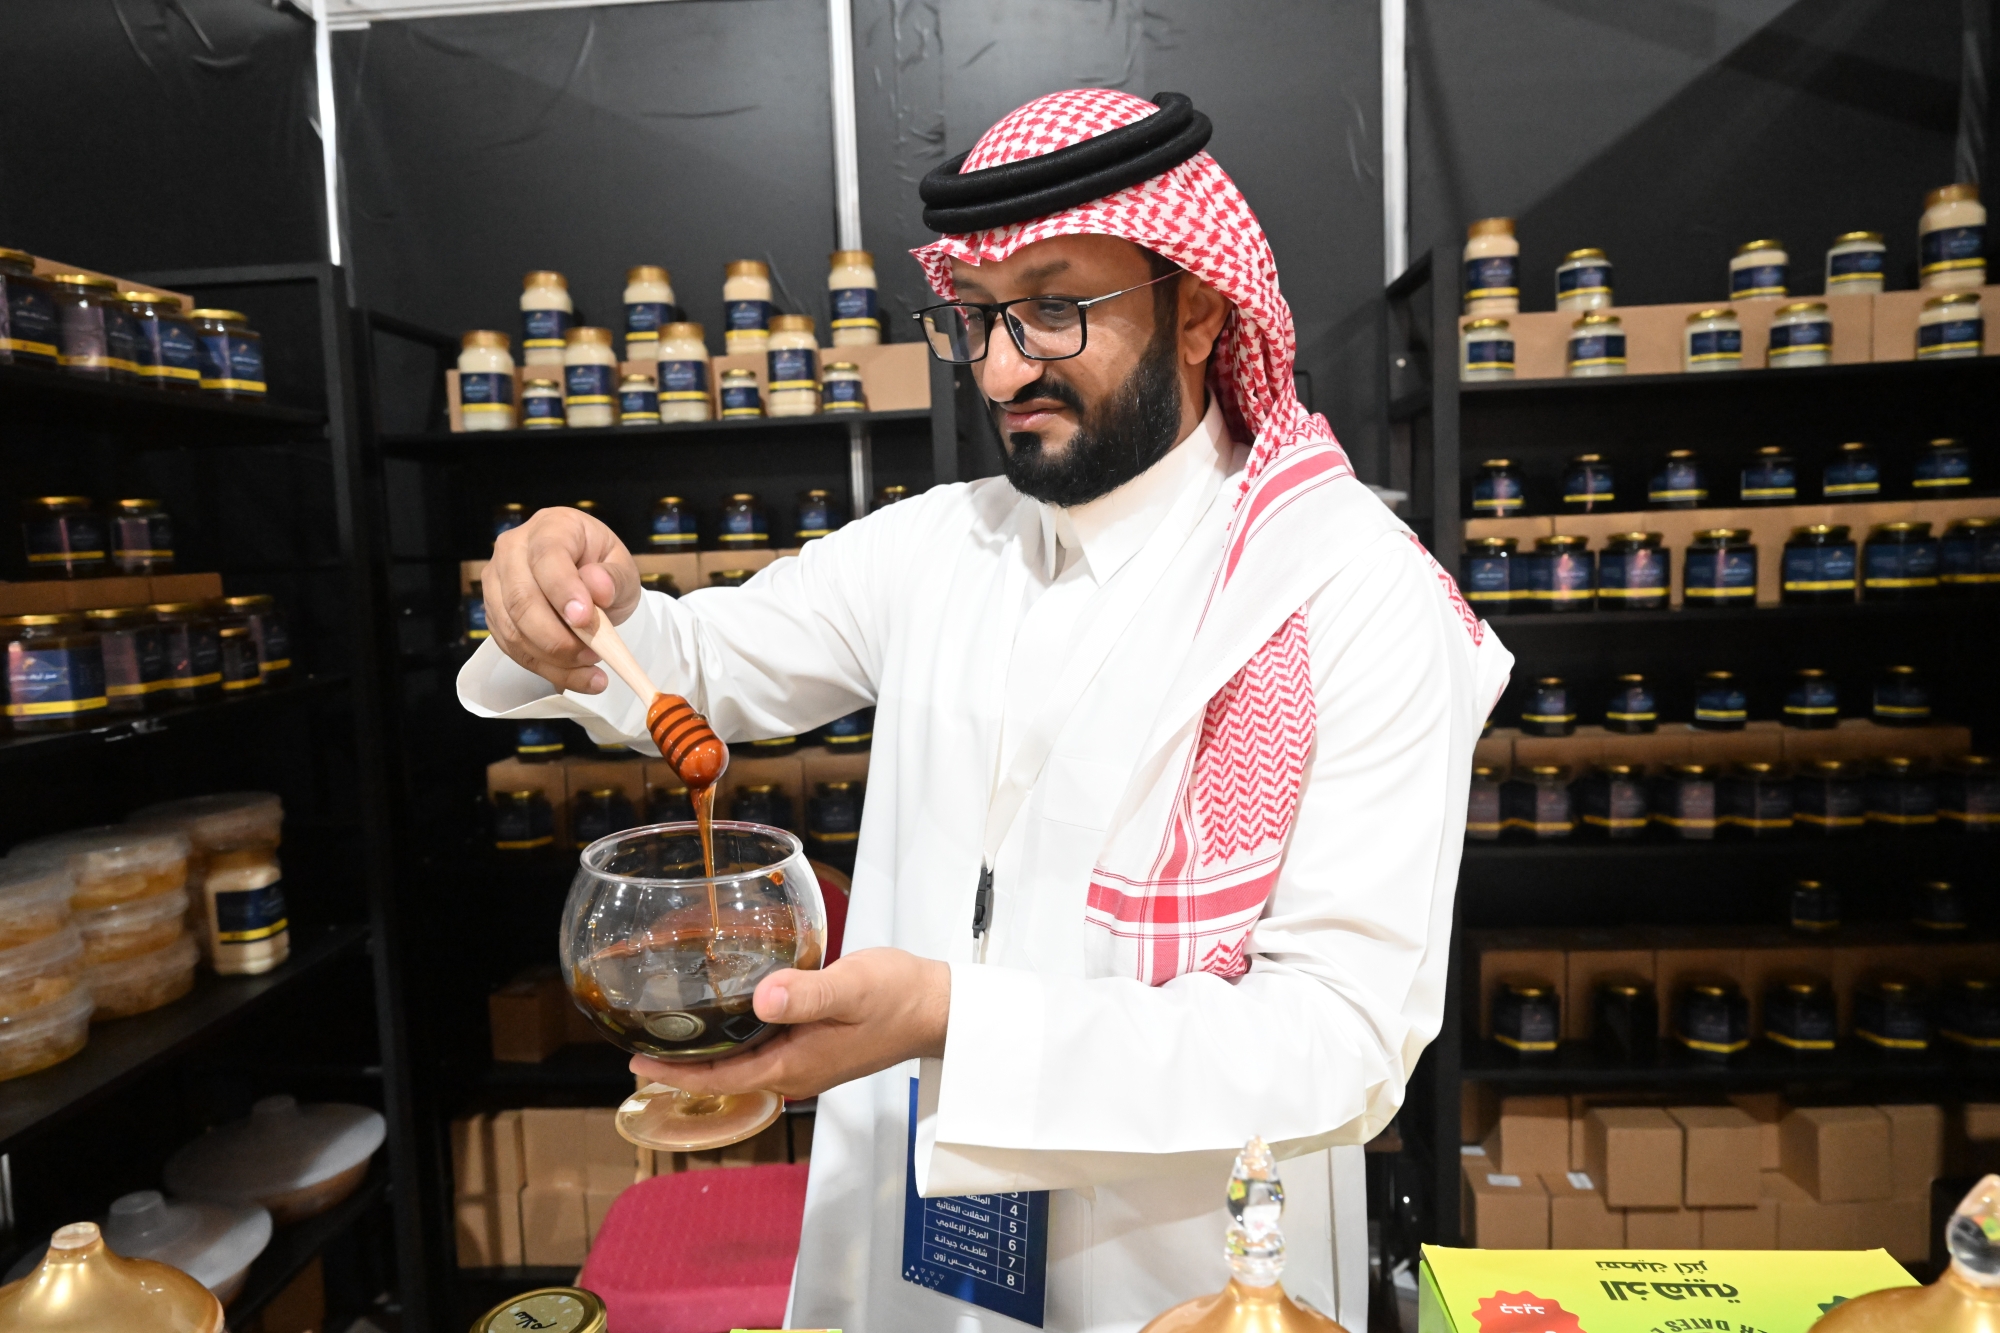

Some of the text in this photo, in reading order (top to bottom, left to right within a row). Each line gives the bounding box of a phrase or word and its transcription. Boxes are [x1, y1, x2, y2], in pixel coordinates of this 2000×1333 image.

[936, 1200, 1017, 1233] 5 الحفلات الغنائية
[1010, 1205, 1018, 1216] 4
[936, 1218, 1016, 1251] 6 المركز الإعلامي
[934, 1251, 1015, 1285] 8 ميكس زون
[1008, 1257, 1016, 1268] 7
[1595, 1259, 1708, 1275] تعطيك أكثر
[1599, 1278, 1742, 1304] الذهبية
[1499, 1302, 1545, 1314] جديد
[1664, 1318, 1730, 1332] DATES
